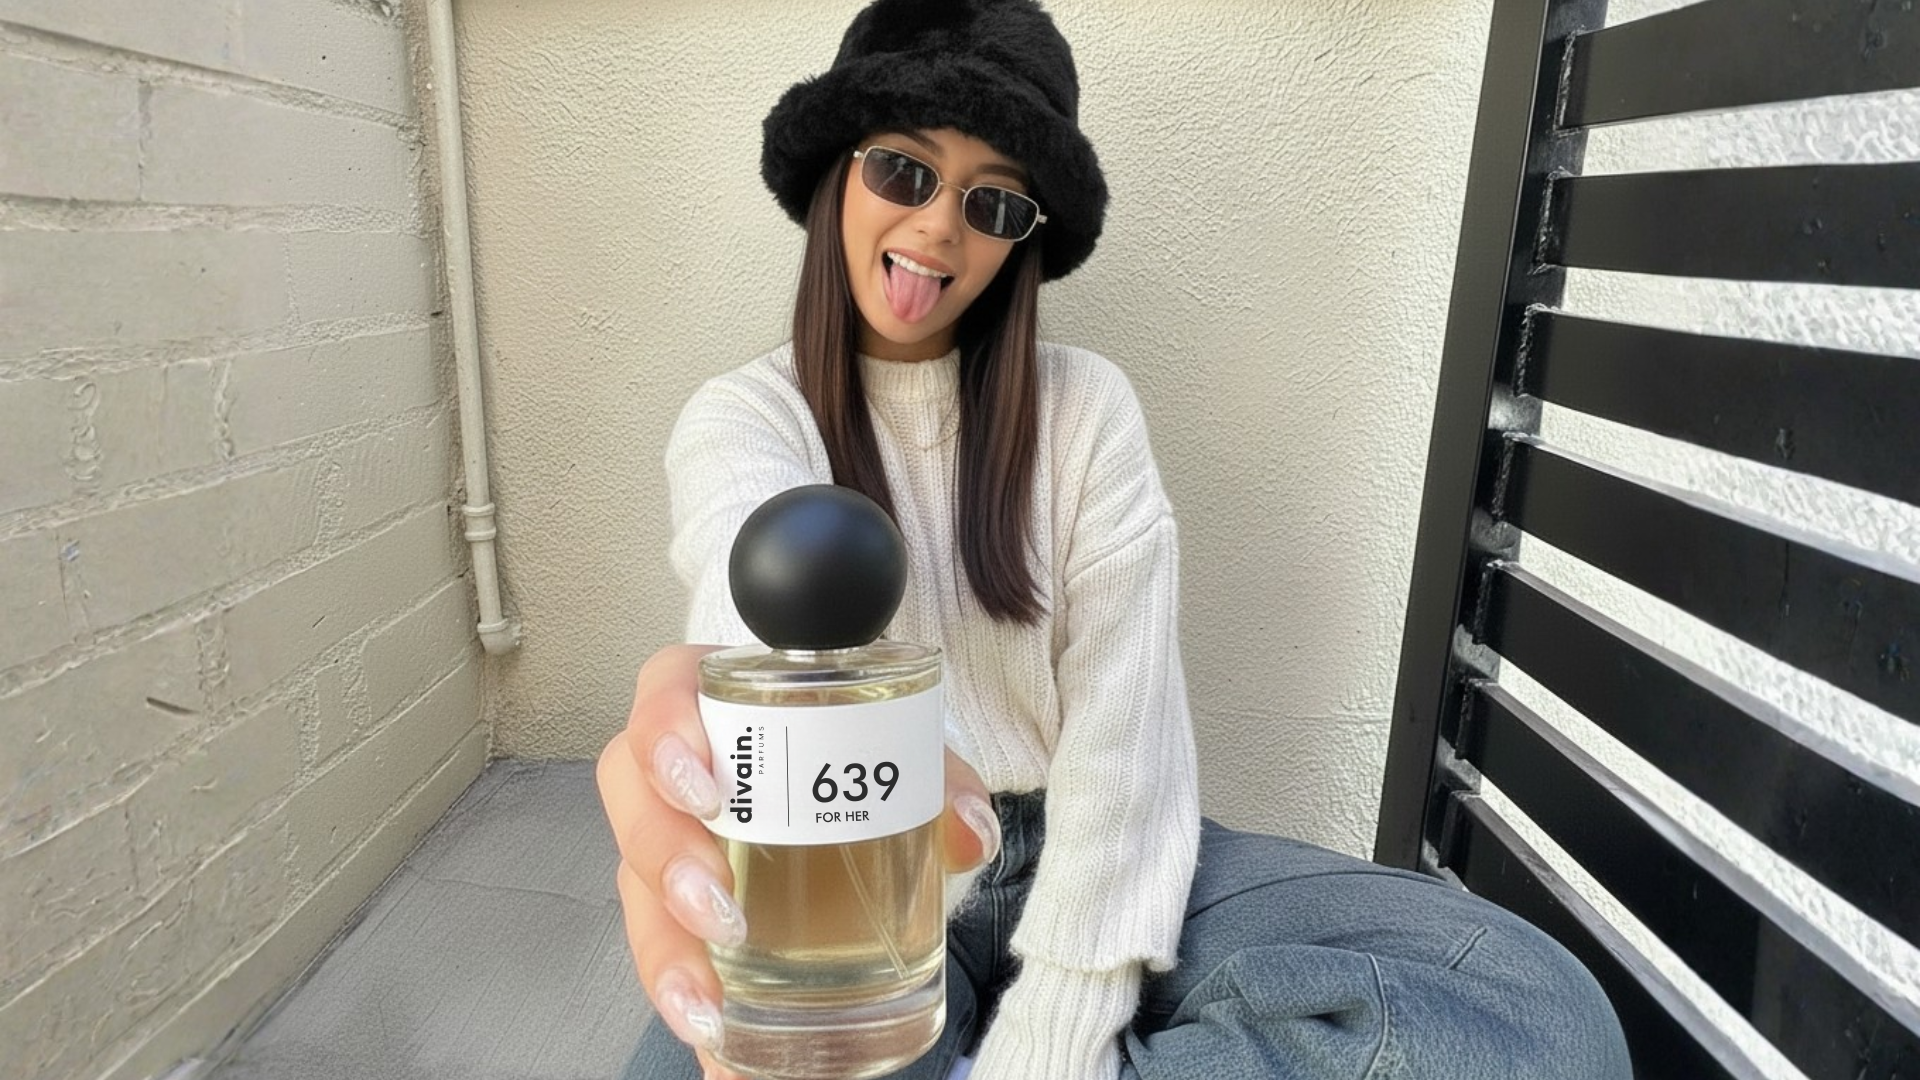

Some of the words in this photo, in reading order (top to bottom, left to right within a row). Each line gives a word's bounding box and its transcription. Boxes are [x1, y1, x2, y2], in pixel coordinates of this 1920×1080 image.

[730, 726, 752, 824] divain.
[812, 761, 900, 803] 639
[815, 812, 841, 824] FOR
[845, 810, 870, 823] HER
